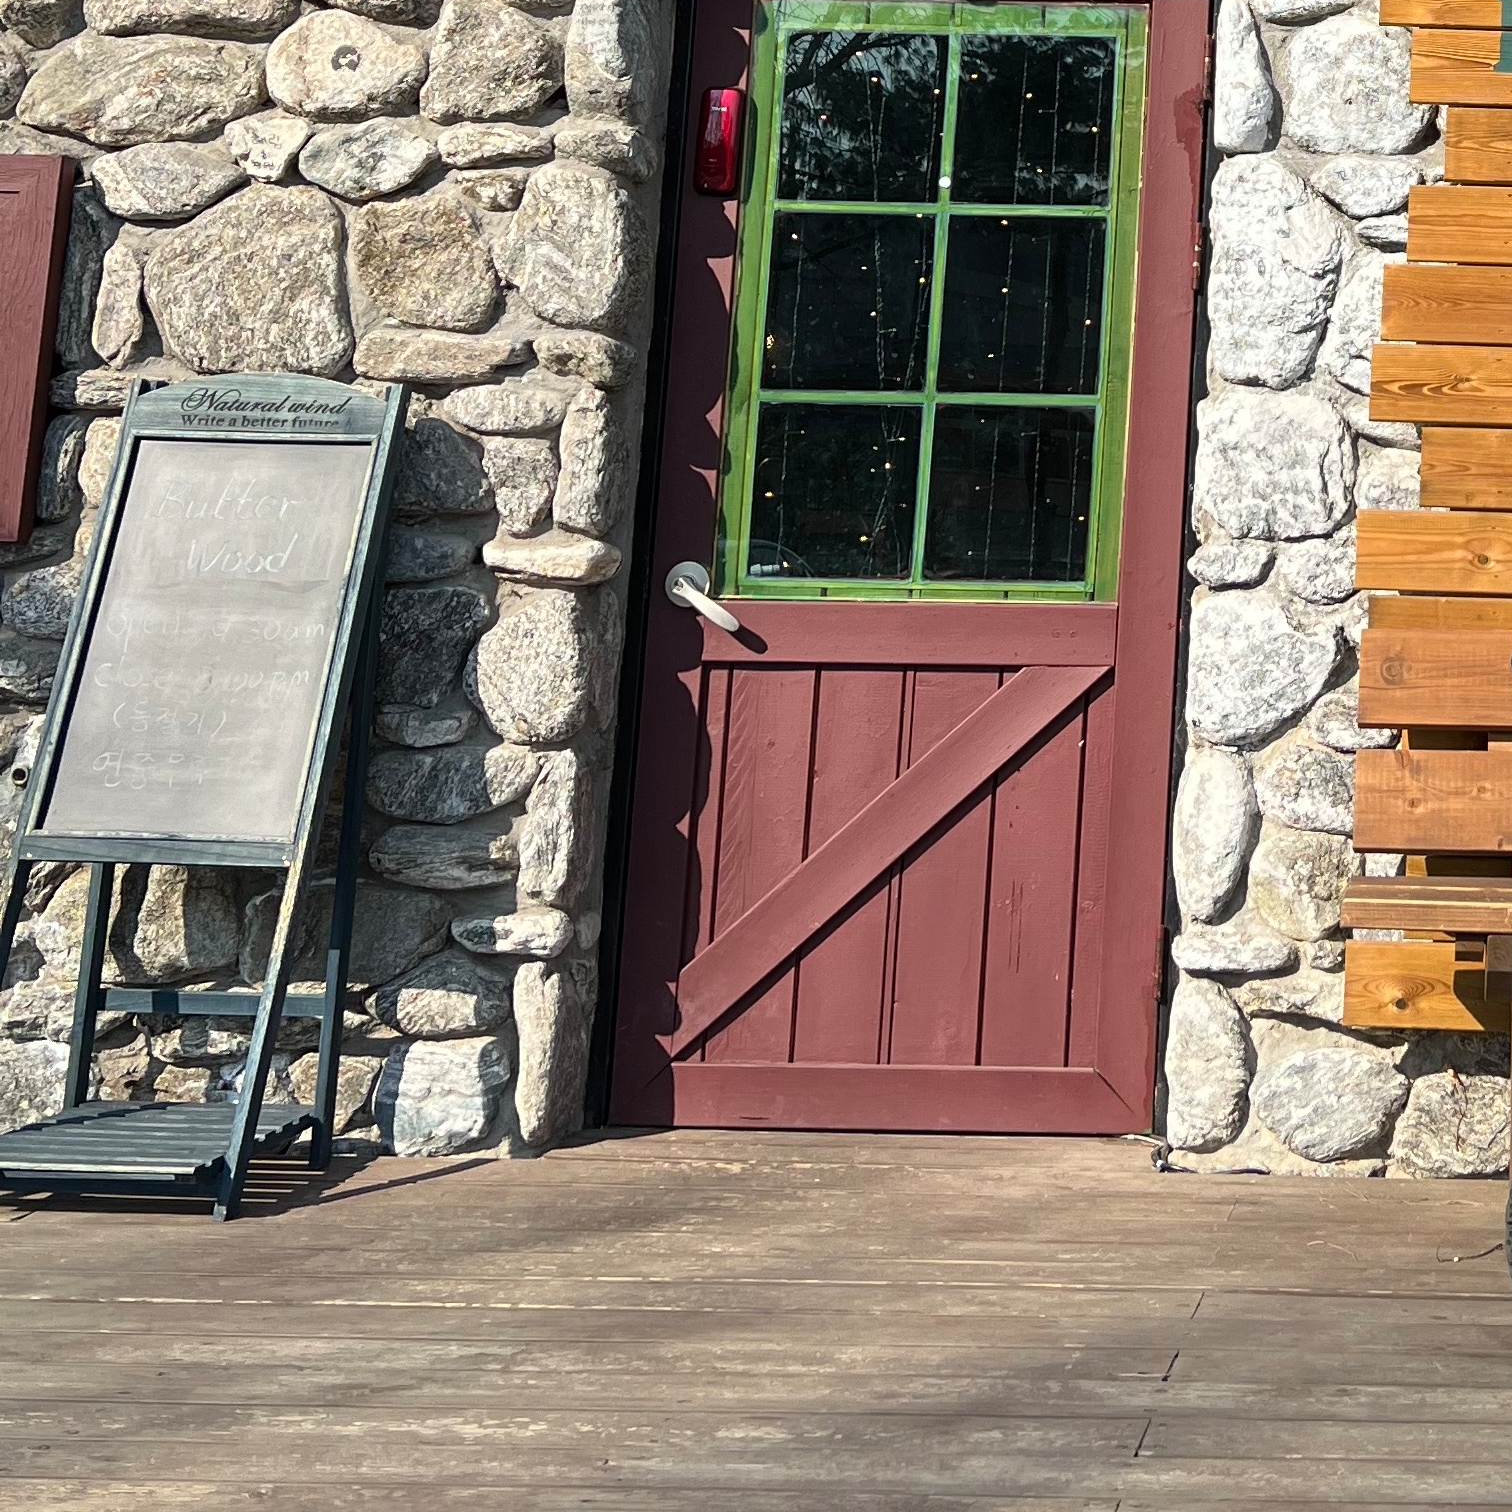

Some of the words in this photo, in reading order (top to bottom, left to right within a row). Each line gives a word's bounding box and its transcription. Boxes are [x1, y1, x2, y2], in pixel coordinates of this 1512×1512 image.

[181, 387, 291, 413] Natural
[287, 396, 353, 415] wind
[181, 414, 226, 427] Write
[228, 418, 237, 427] a
[241, 415, 289, 428] better
[186, 531, 298, 574] Wood
